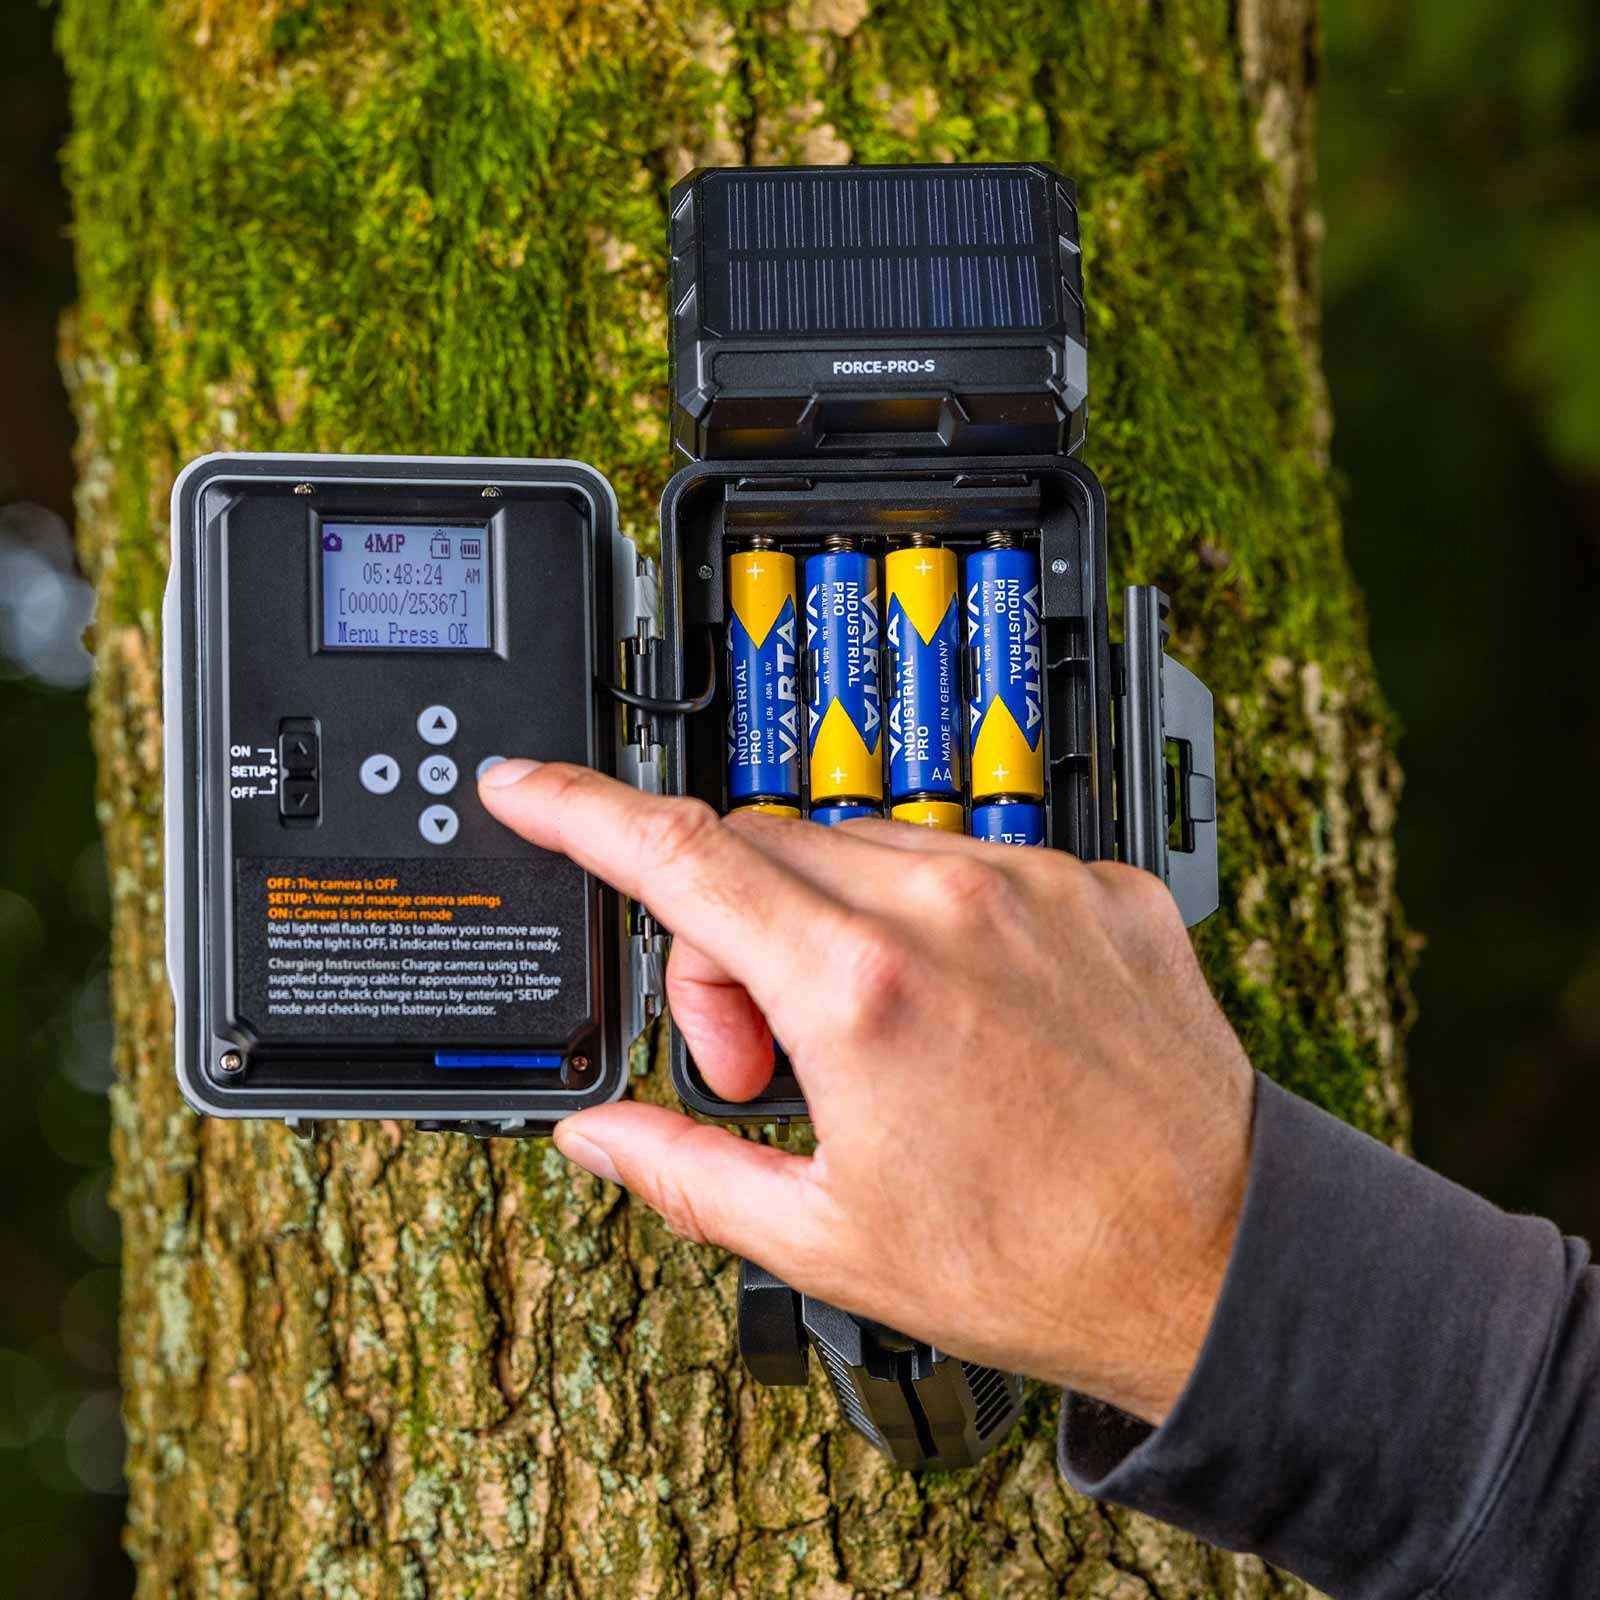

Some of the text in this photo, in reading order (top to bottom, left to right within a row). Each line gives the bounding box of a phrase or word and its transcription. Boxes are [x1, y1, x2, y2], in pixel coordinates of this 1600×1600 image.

[833, 359, 935, 374] FORCE-PRO-S
[364, 533, 406, 554] 4MP
[363, 563, 481, 585] 05:48:24 AM
[339, 588, 467, 617] [00000/25367]
[821, 583, 829, 620] ALKALINE
[832, 581, 845, 616] PRO
[982, 580, 990, 617] ALKALINE
[993, 579, 1006, 613] PRO
[338, 622, 468, 644] Menu Press OK
[846, 582, 860, 688] INDUSTRIAL
[1007, 579, 1022, 685] INDUSTRIAL
[806, 584, 820, 737] VAA
[861, 586, 880, 732] VARTA
[967, 582, 982, 735] VAA
[1022, 583, 1041, 730] VARTA
[776, 617, 798, 765] VARTA
[887, 613, 902, 764] VAA
[939, 639, 951, 761] MADE IN GERMANY
[735, 659, 749, 766] INDUSTRIAL
[766, 706, 774, 721] LR6
[902, 655, 916, 762] INDUSTRIAL
[230, 745, 251, 757] ON
[749, 729, 762, 765] PRO
[766, 727, 775, 764] ALKALINE
[917, 725, 929, 761] PRO
[231, 765, 271, 778] SETUP
[430, 766, 450, 782] OK
[931, 767, 953, 781] AA
[231, 786, 258, 799] OFF
[267, 878, 398, 889] OFF: The camera is OFF
[268, 893, 502, 908] SETUP: View and manage camera settings
[268, 908, 453, 920] ON: Camera is in detection mode
[268, 923, 561, 938] Red light will flash for 30 s to allow you to move away.
[268, 937, 561, 952] When the light is OFF, it indicates the camera is ready.
[268, 958, 539, 973] Charging Instructions: Charge camera using the
[268, 973, 561, 987] supplied charging cable for approximately 12 h before
[268, 990, 292, 999] use.
[293, 988, 314, 999] You
[316, 990, 337, 999] can
[338, 989, 371, 999] check
[373, 989, 412, 1002] charge
[414, 990, 448, 1000] status
[449, 989, 463, 1002] by
[465, 990, 513, 1003] entering
[268, 1003, 496, 1017] mode and checking the battery indicator.
